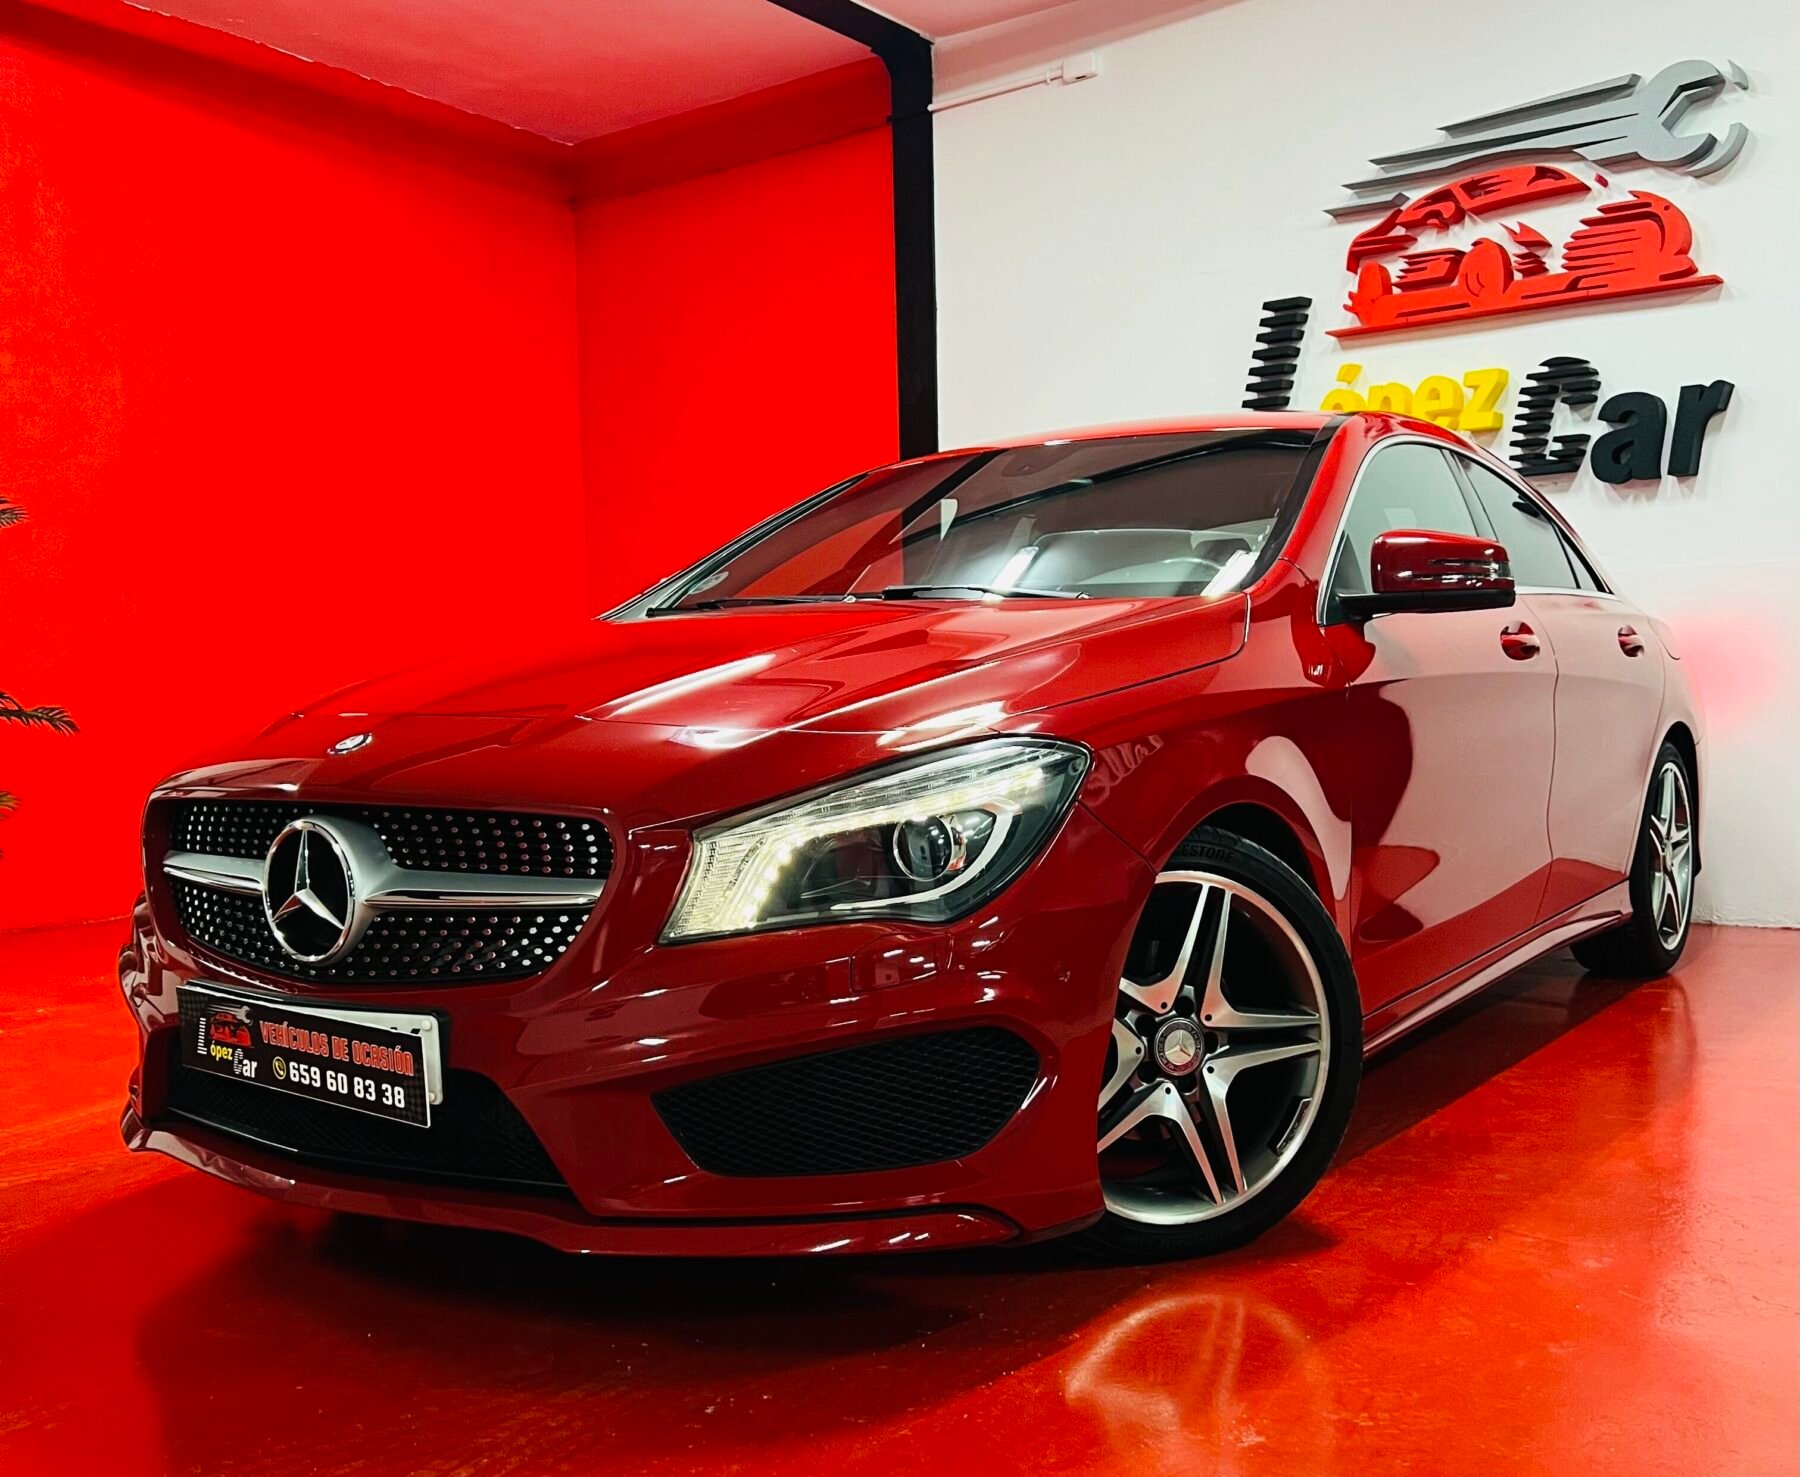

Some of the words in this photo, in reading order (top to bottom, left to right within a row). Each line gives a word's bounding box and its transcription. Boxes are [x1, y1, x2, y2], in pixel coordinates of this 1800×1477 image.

[1509, 356, 1736, 485] Car
[197, 1017, 233, 1061] López
[233, 1048, 258, 1078] Car
[331, 1035, 350, 1062] DE
[289, 1061, 321, 1088] 659
[326, 1070, 348, 1094] 60
[353, 1076, 376, 1101] 83
[381, 1083, 405, 1109] 38
